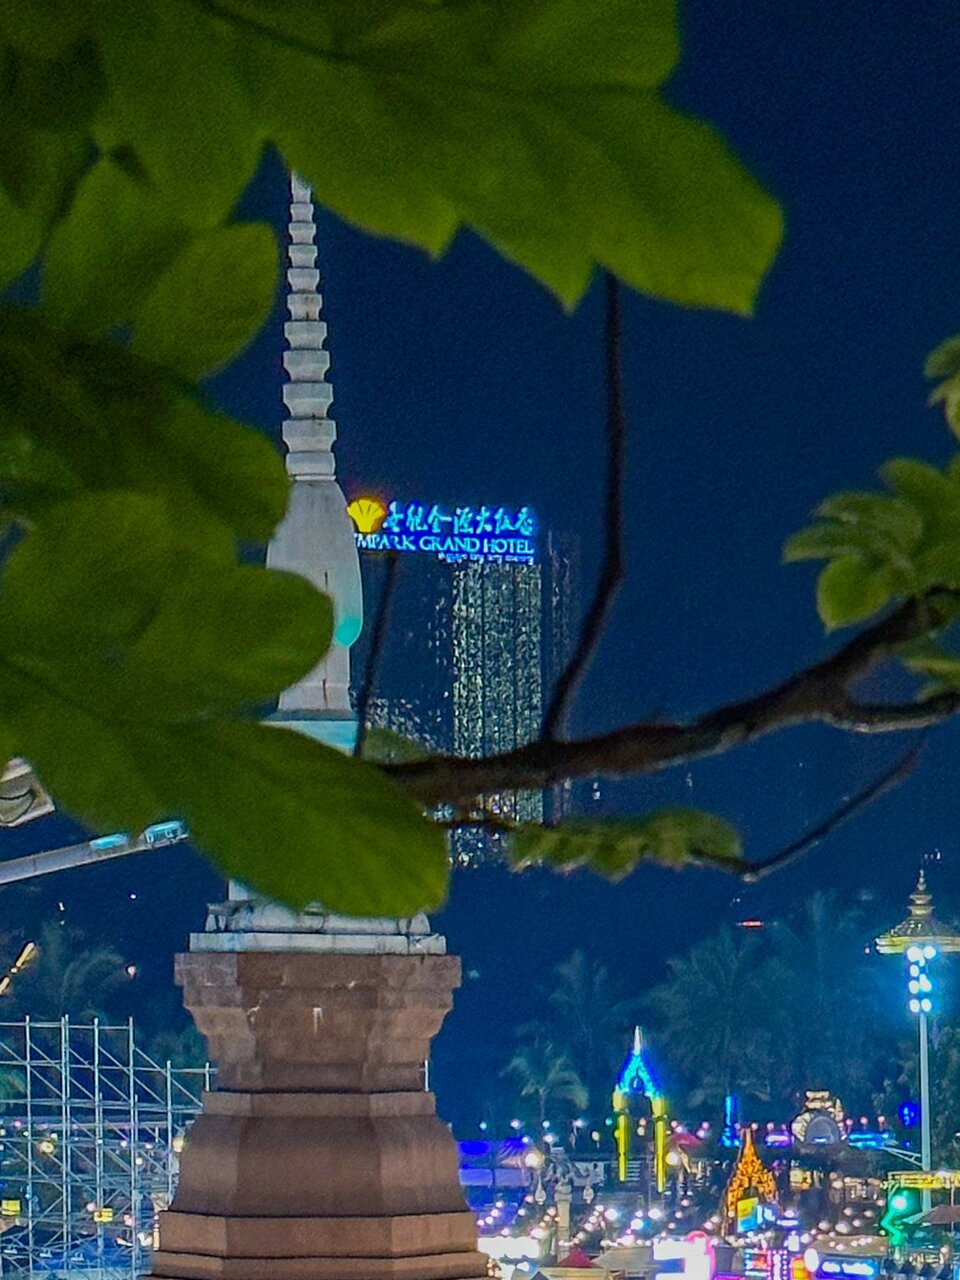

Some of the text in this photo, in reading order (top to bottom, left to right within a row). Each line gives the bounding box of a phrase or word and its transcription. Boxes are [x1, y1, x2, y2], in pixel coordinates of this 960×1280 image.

[354, 533, 534, 554] MPARK GRAND HOTEL
